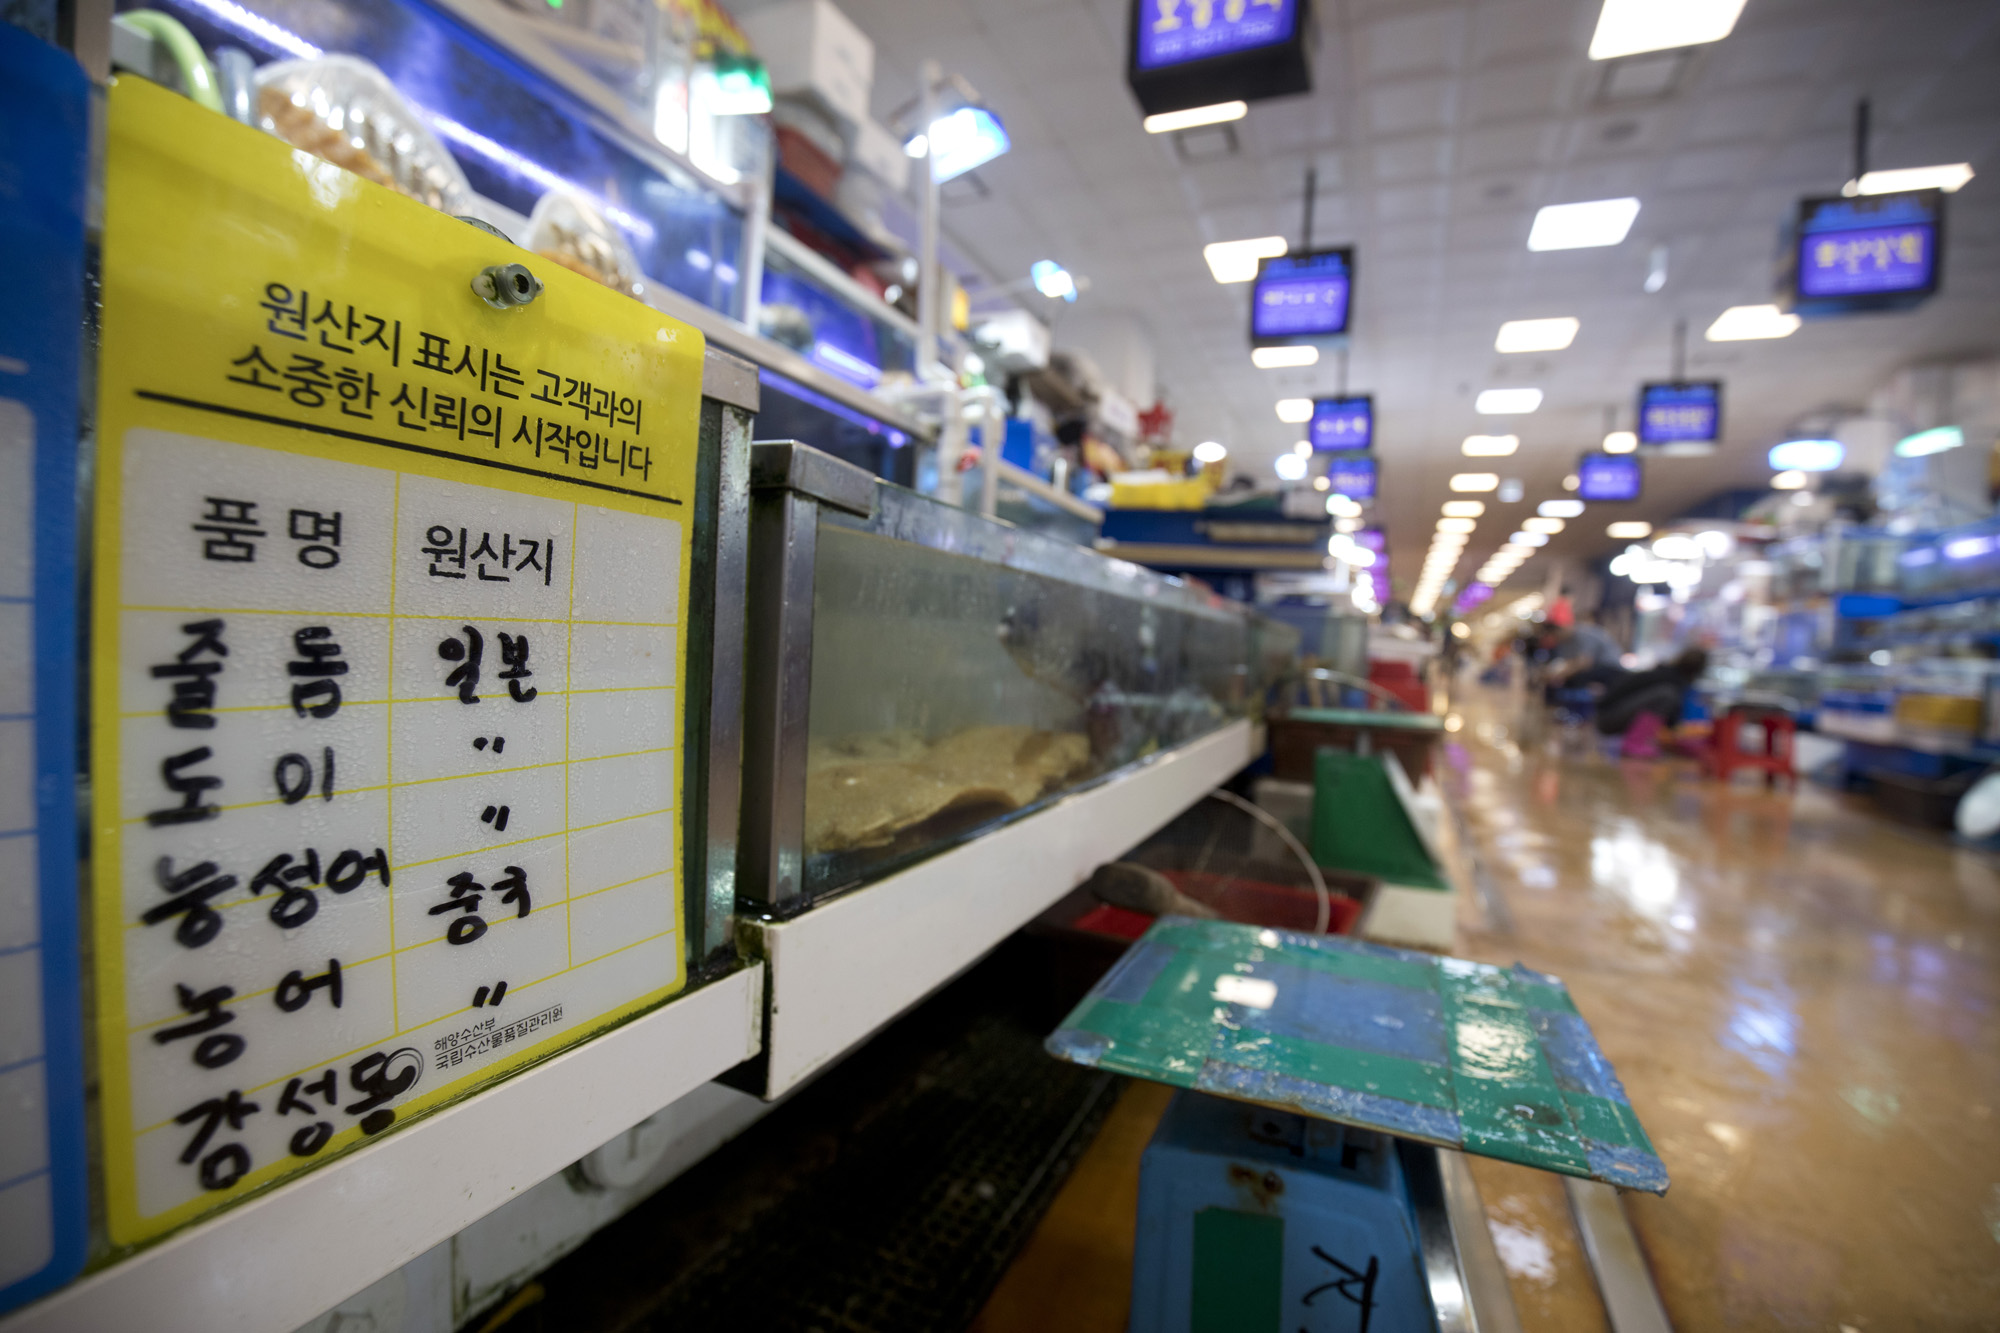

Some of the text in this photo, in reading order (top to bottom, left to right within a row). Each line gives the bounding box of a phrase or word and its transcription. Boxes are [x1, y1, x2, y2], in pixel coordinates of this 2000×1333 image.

[260, 282, 643, 435] 원산지 표시는 고객과의
[227, 345, 652, 481] 소중한 신뢰의 시작입니다
[421, 524, 554, 586] 원산지
[434, 1017, 496, 1051] 해양수산부
[435, 1006, 563, 1070] 국립수산물품질관리원
